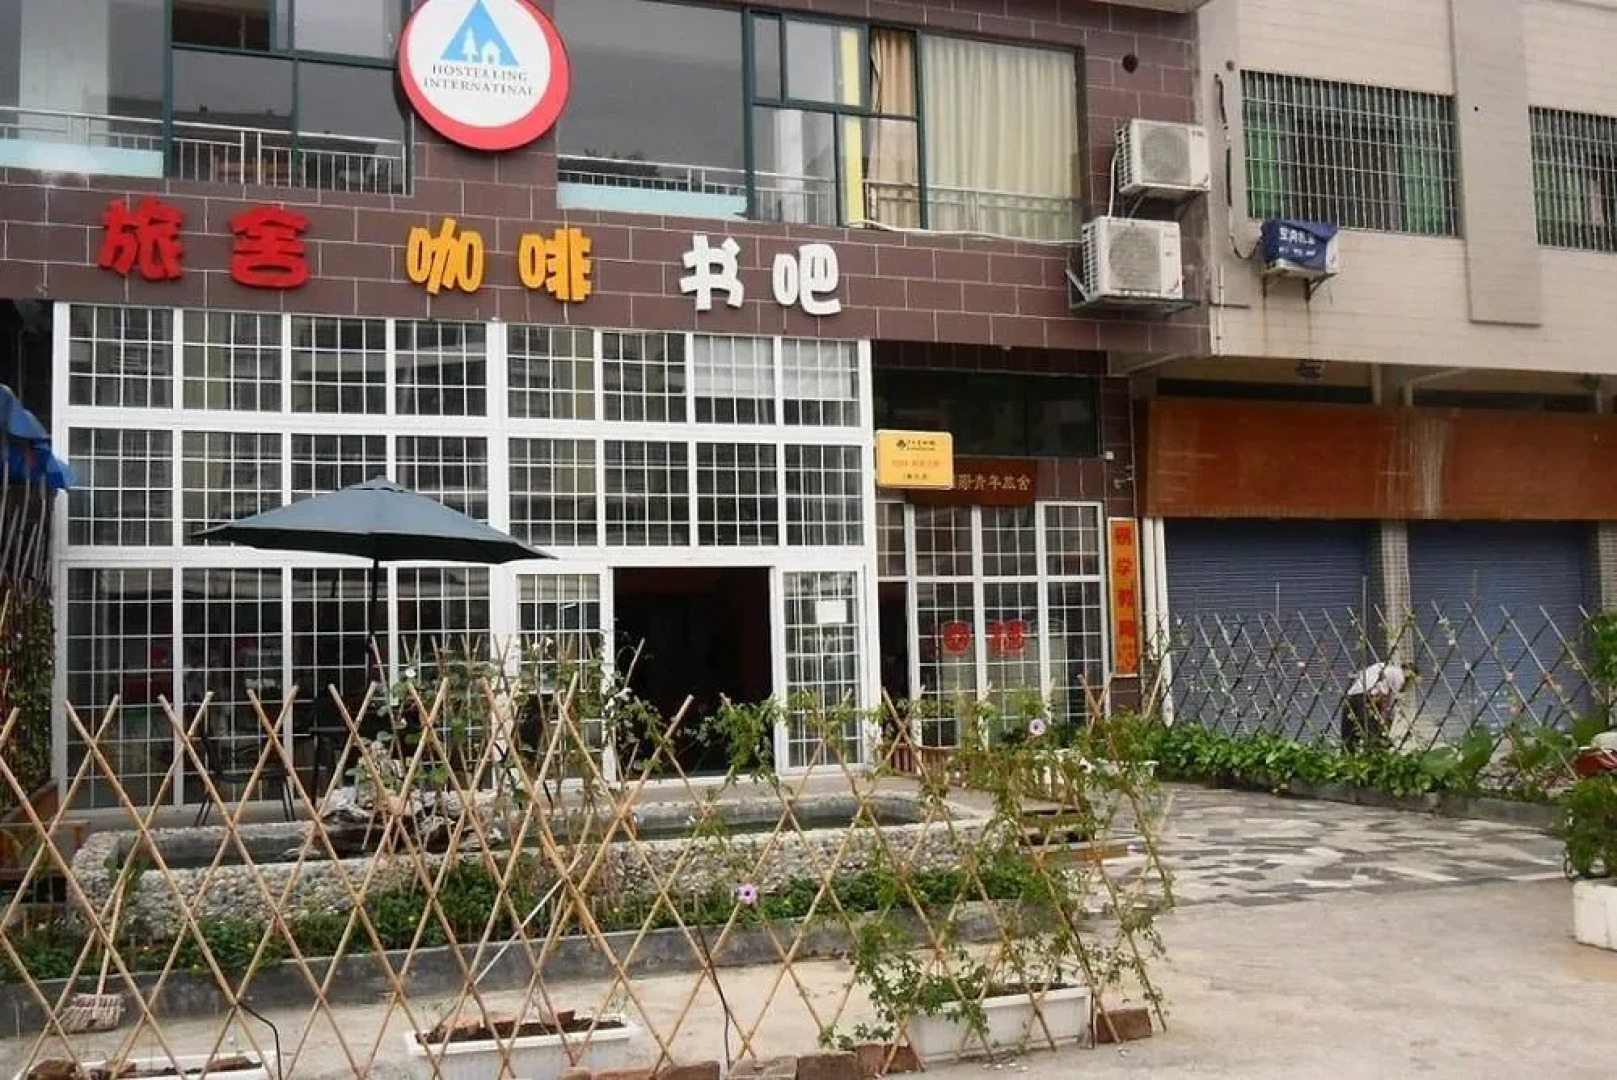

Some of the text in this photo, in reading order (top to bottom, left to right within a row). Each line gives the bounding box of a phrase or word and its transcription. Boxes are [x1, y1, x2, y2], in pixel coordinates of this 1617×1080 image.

[432, 64, 528, 82] HOSTELLING
[100, 195, 842, 315] 旅舍 咖啡 书吧
